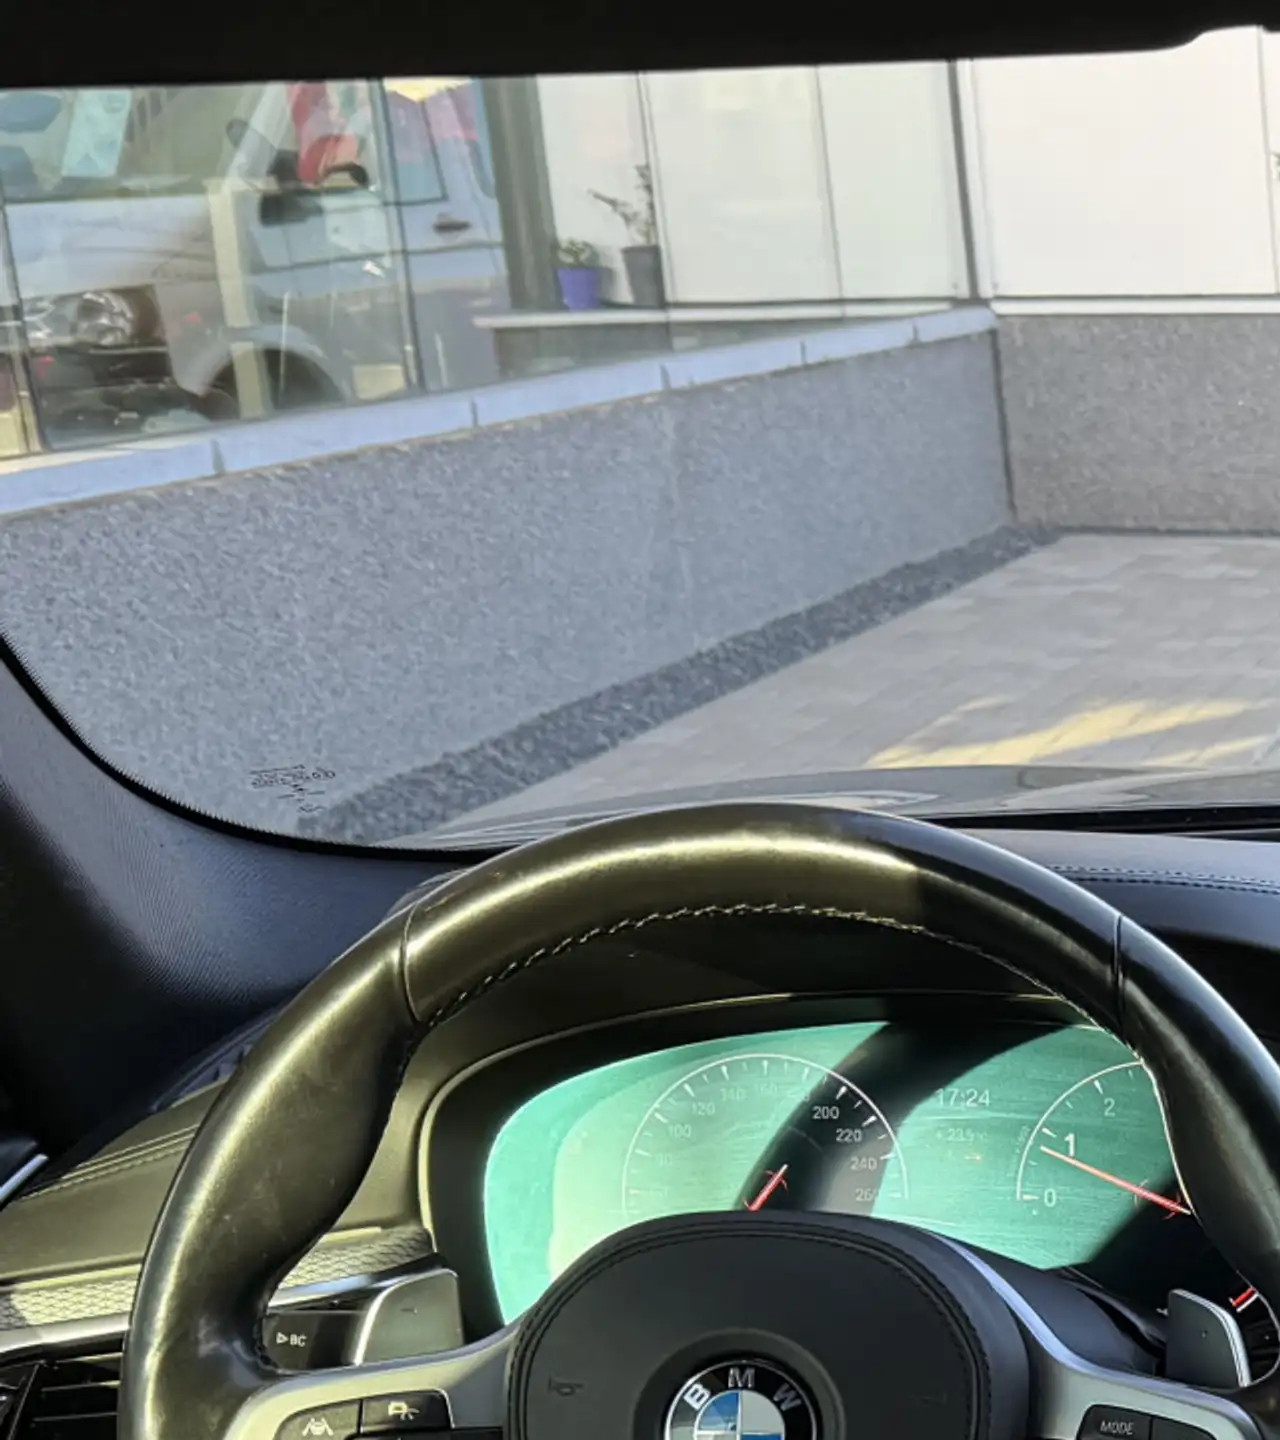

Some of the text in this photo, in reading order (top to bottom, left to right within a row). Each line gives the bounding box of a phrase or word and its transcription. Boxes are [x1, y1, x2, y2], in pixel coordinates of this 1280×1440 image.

[936, 1088, 991, 1107] 17:24
[811, 1105, 841, 1120] 200
[1102, 1099, 1116, 1118] 2
[669, 1123, 693, 1139] 100
[835, 1128, 864, 1143] 220
[1063, 1133, 1076, 1158] 1
[849, 1156, 879, 1171] 240
[1043, 1189, 1057, 1208] 0
[289, 1332, 308, 1348] BC
[683, 1366, 802, 1411] BMW
[1099, 1419, 1135, 1436] MODE
